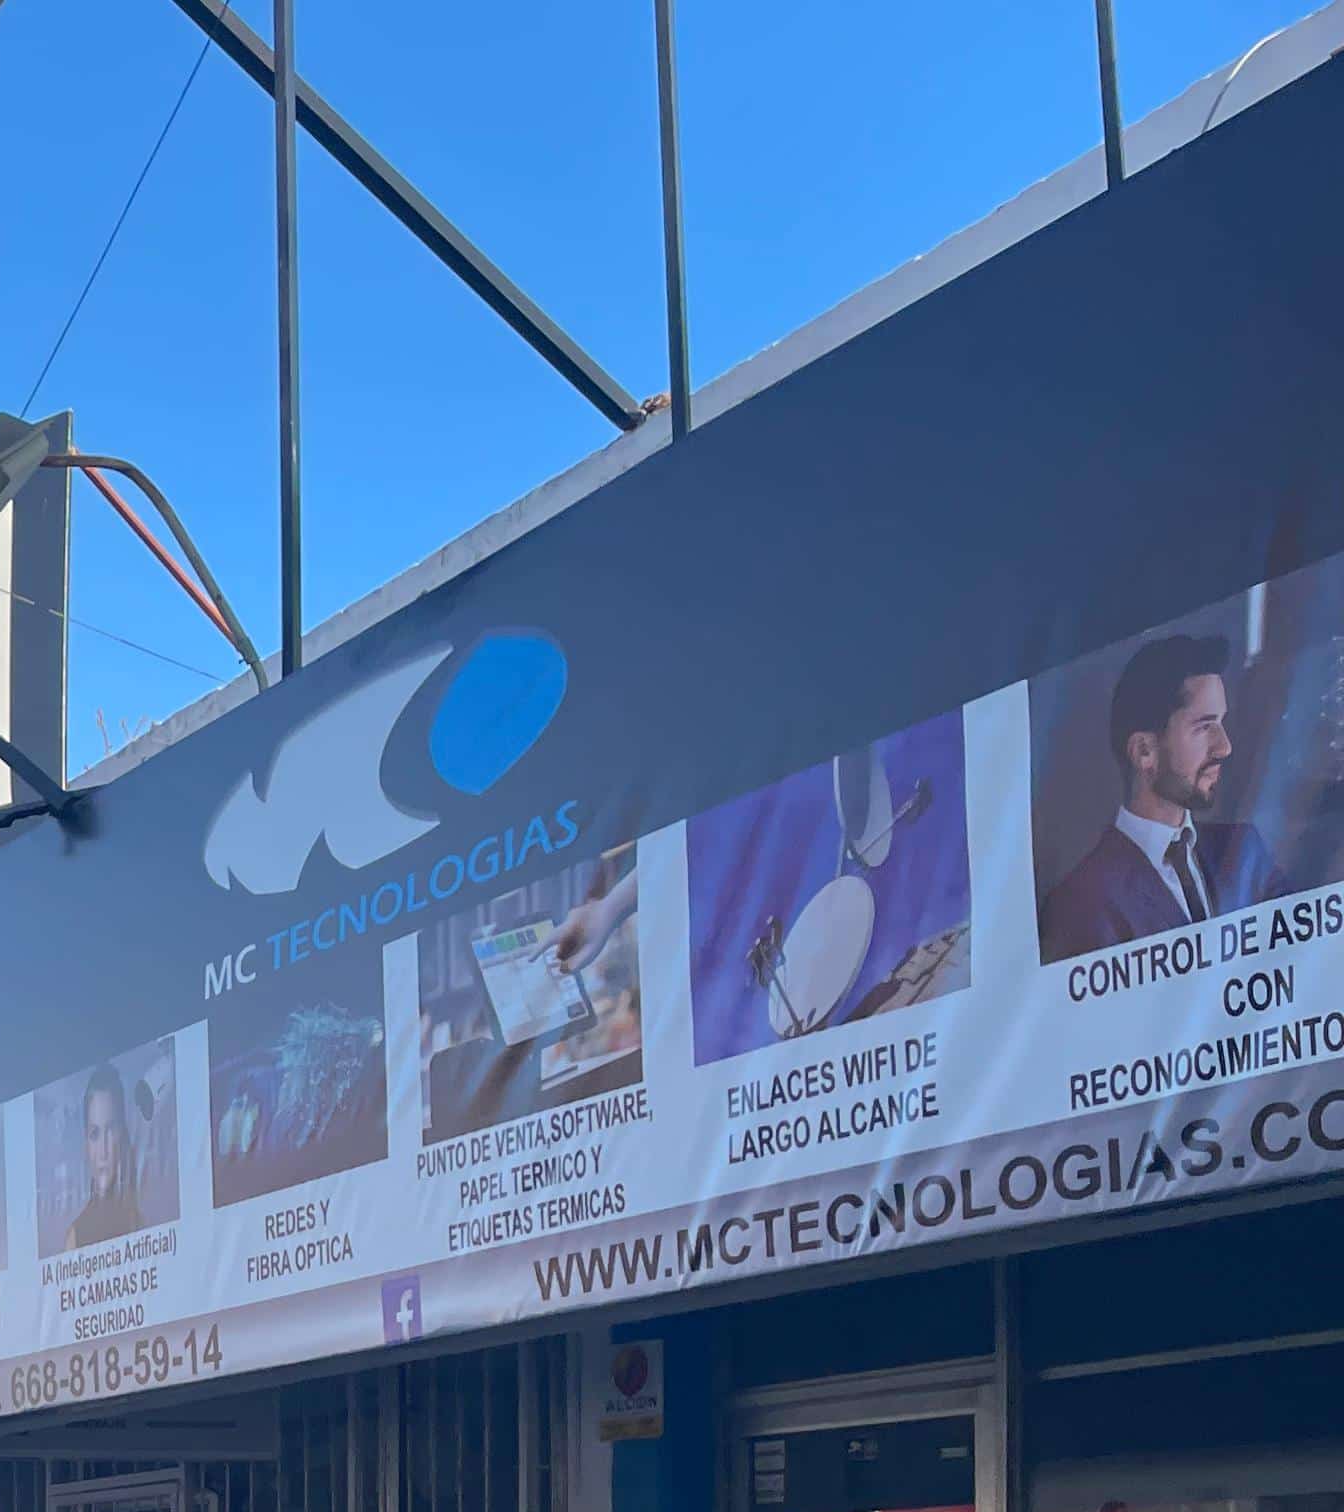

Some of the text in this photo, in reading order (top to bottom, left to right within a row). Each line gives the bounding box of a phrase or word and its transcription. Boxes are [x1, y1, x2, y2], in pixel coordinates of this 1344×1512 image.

[204, 801, 580, 1000] MC TECNOLOGIAS
[1069, 934, 1212, 1003] CONTROL
[1220, 915, 1259, 963] DE
[1223, 965, 1296, 1018] CON
[727, 1031, 938, 1119] ENLACES WIFI DE
[1070, 1011, 1344, 1111] RECONOCIMIENTO
[728, 1083, 940, 1165] LARGO ALCANCE
[417, 1143, 467, 1179] PUNTO
[470, 1133, 492, 1166] DE
[460, 1145, 603, 1208] PAPEL TERMICO Y
[264, 1198, 331, 1241] REDES Y
[448, 1183, 626, 1252] ETIQUETAS TERMICAS
[42, 1227, 177, 1286] IA (Inteligencia Artificial)
[247, 1231, 353, 1283] FIBRA OPTICA
[60, 1266, 158, 1312] EN CAMARAS DE
[74, 1303, 145, 1341] SEGURIDAD
[12, 1323, 223, 1409] 668-818-59-14
